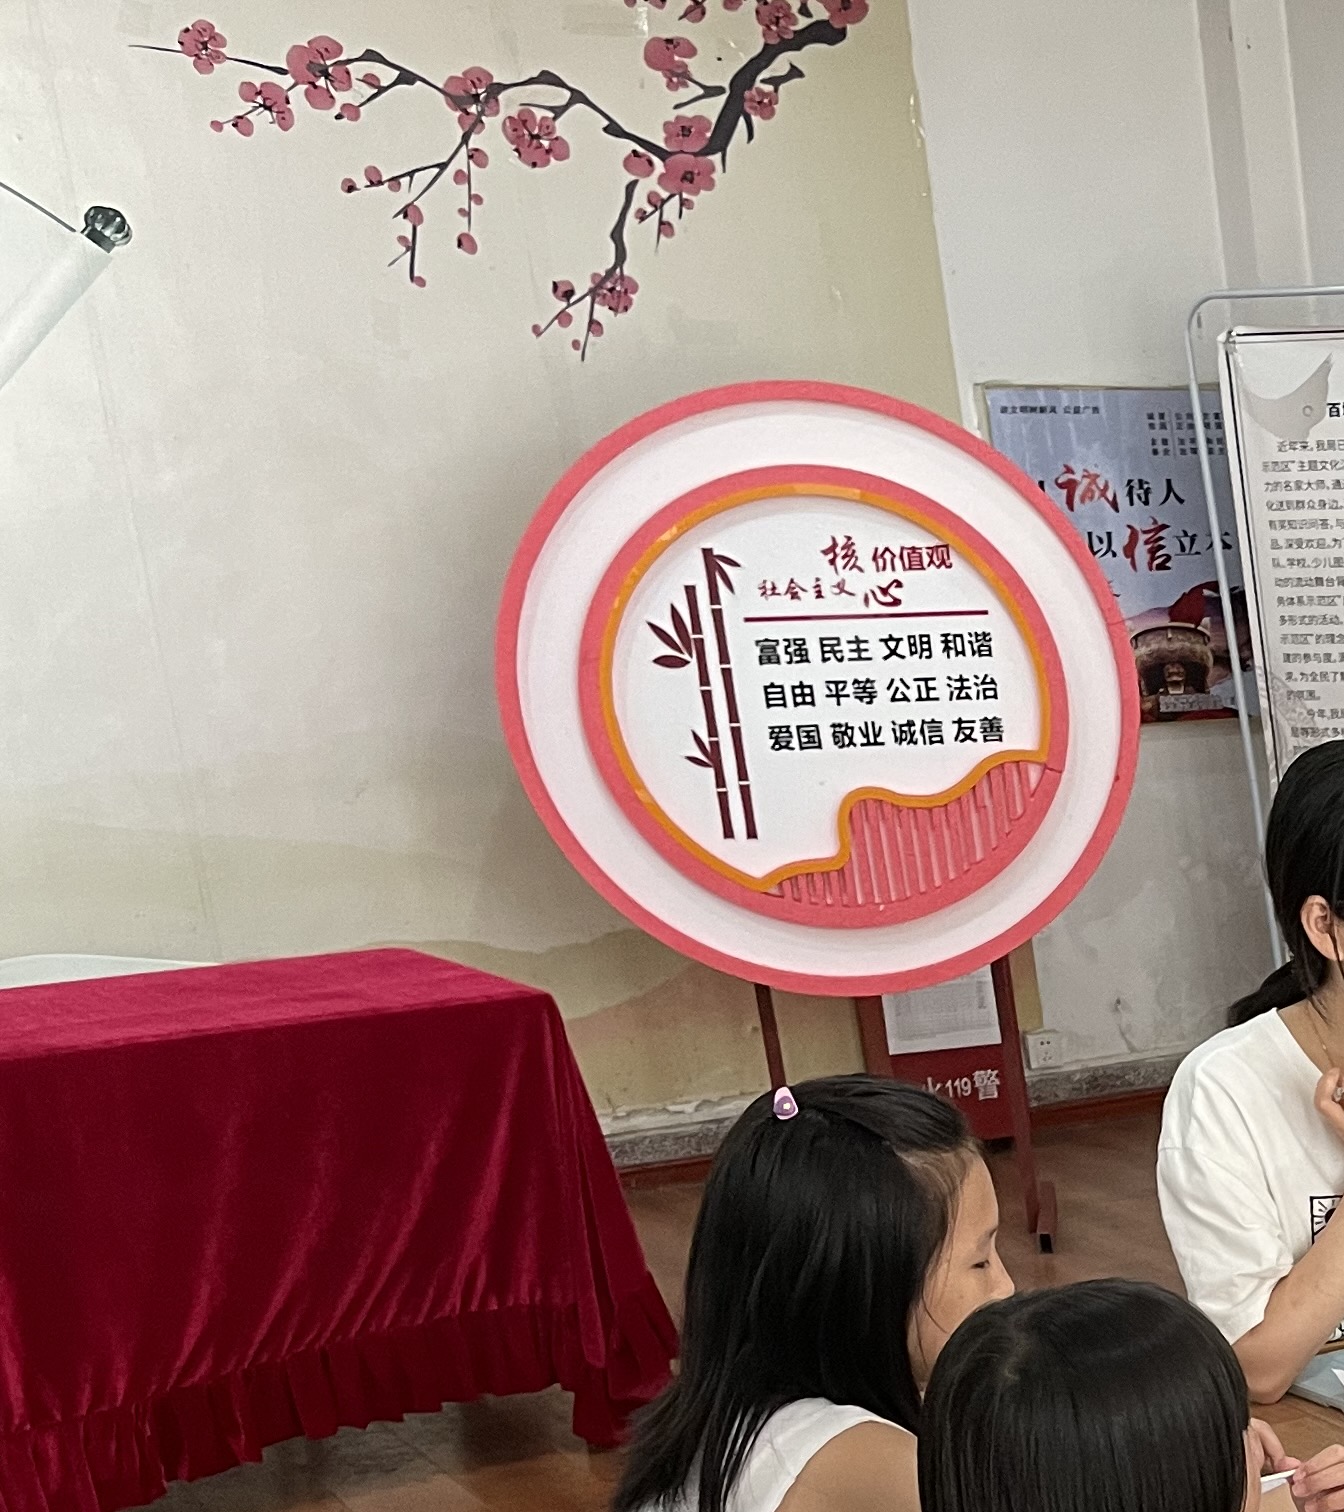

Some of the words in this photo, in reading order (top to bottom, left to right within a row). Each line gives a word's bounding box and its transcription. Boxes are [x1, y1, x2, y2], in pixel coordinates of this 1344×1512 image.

[821, 536, 865, 575] 核
[872, 544, 953, 572] 价值观
[757, 577, 856, 601] 社会主义
[863, 579, 904, 607] 心
[755, 637, 812, 666] 富强
[819, 635, 873, 663] 民主
[879, 633, 933, 661] 文明
[940, 631, 993, 659] 和谐
[763, 681, 816, 709] 自由
[825, 678, 878, 706] 平等
[886, 676, 940, 703] 公正
[946, 674, 999, 702] 法治
[768, 724, 823, 751] 爱国
[829, 721, 885, 749] 敬业
[891, 718, 945, 746] 诚信
[952, 716, 1004, 744] 友善
